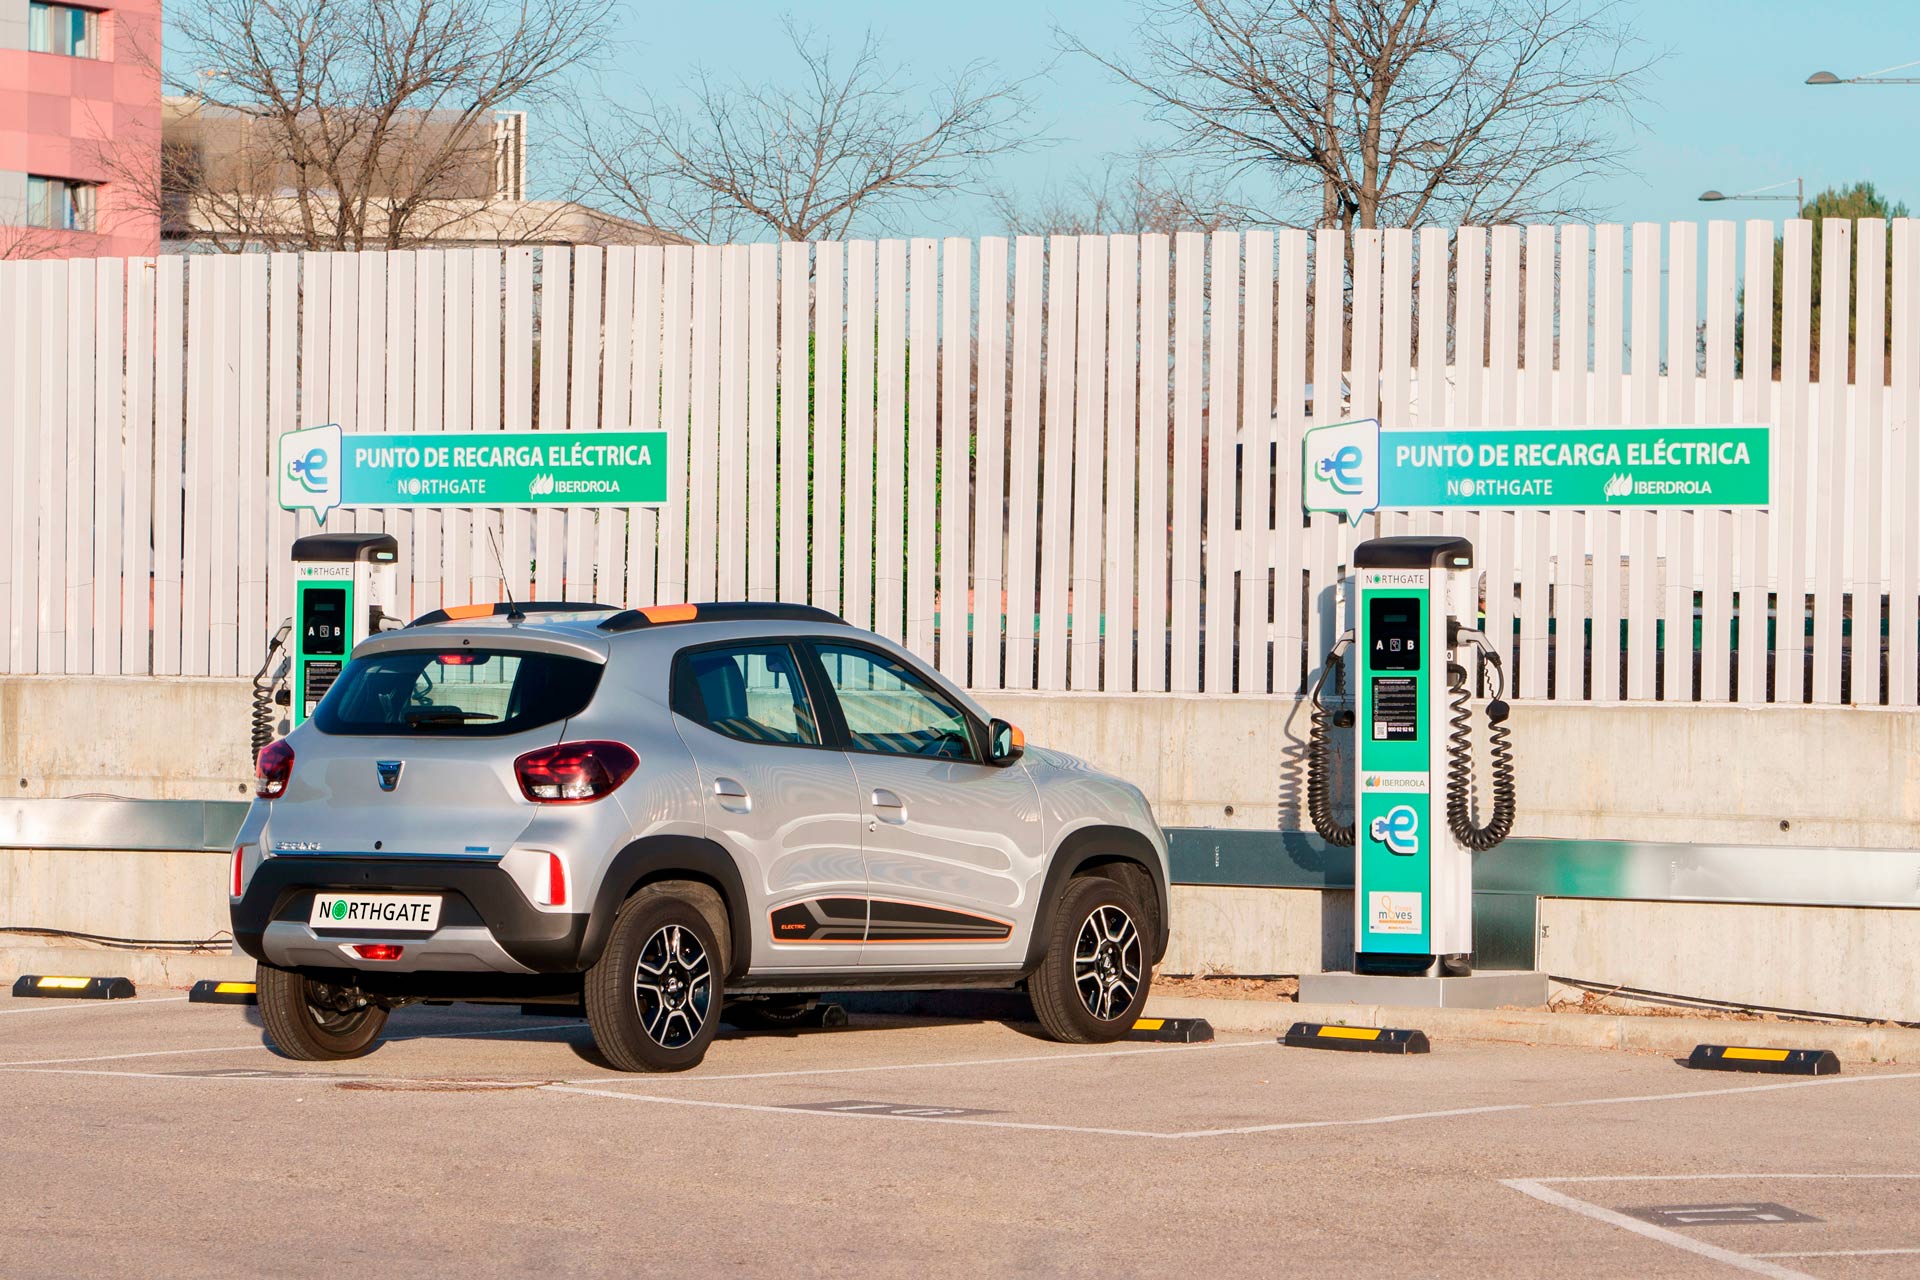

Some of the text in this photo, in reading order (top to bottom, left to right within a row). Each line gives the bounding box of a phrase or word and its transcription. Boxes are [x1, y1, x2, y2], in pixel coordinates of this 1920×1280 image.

[355, 442, 652, 468] PUNTO DE RECARGA ELÉCTRICA
[1396, 438, 1750, 467] PUNTO DE RECARGA ELÉCTRICA
[397, 478, 486, 496] NORTHGATE
[555, 480, 620, 493] IBERDROLA
[1447, 478, 1553, 497] NORTHGATE
[1634, 480, 1712, 494] IBERDROLA
[300, 567, 350, 576] NORTHGATE
[1366, 574, 1424, 584] NORTHGATE
[308, 626, 315, 636] A
[334, 626, 341, 636] B
[1376, 640, 1384, 650] A
[1407, 640, 1415, 650] B
[1382, 779, 1425, 787] IBERDROLA
[319, 899, 431, 921] NORTHGATE
